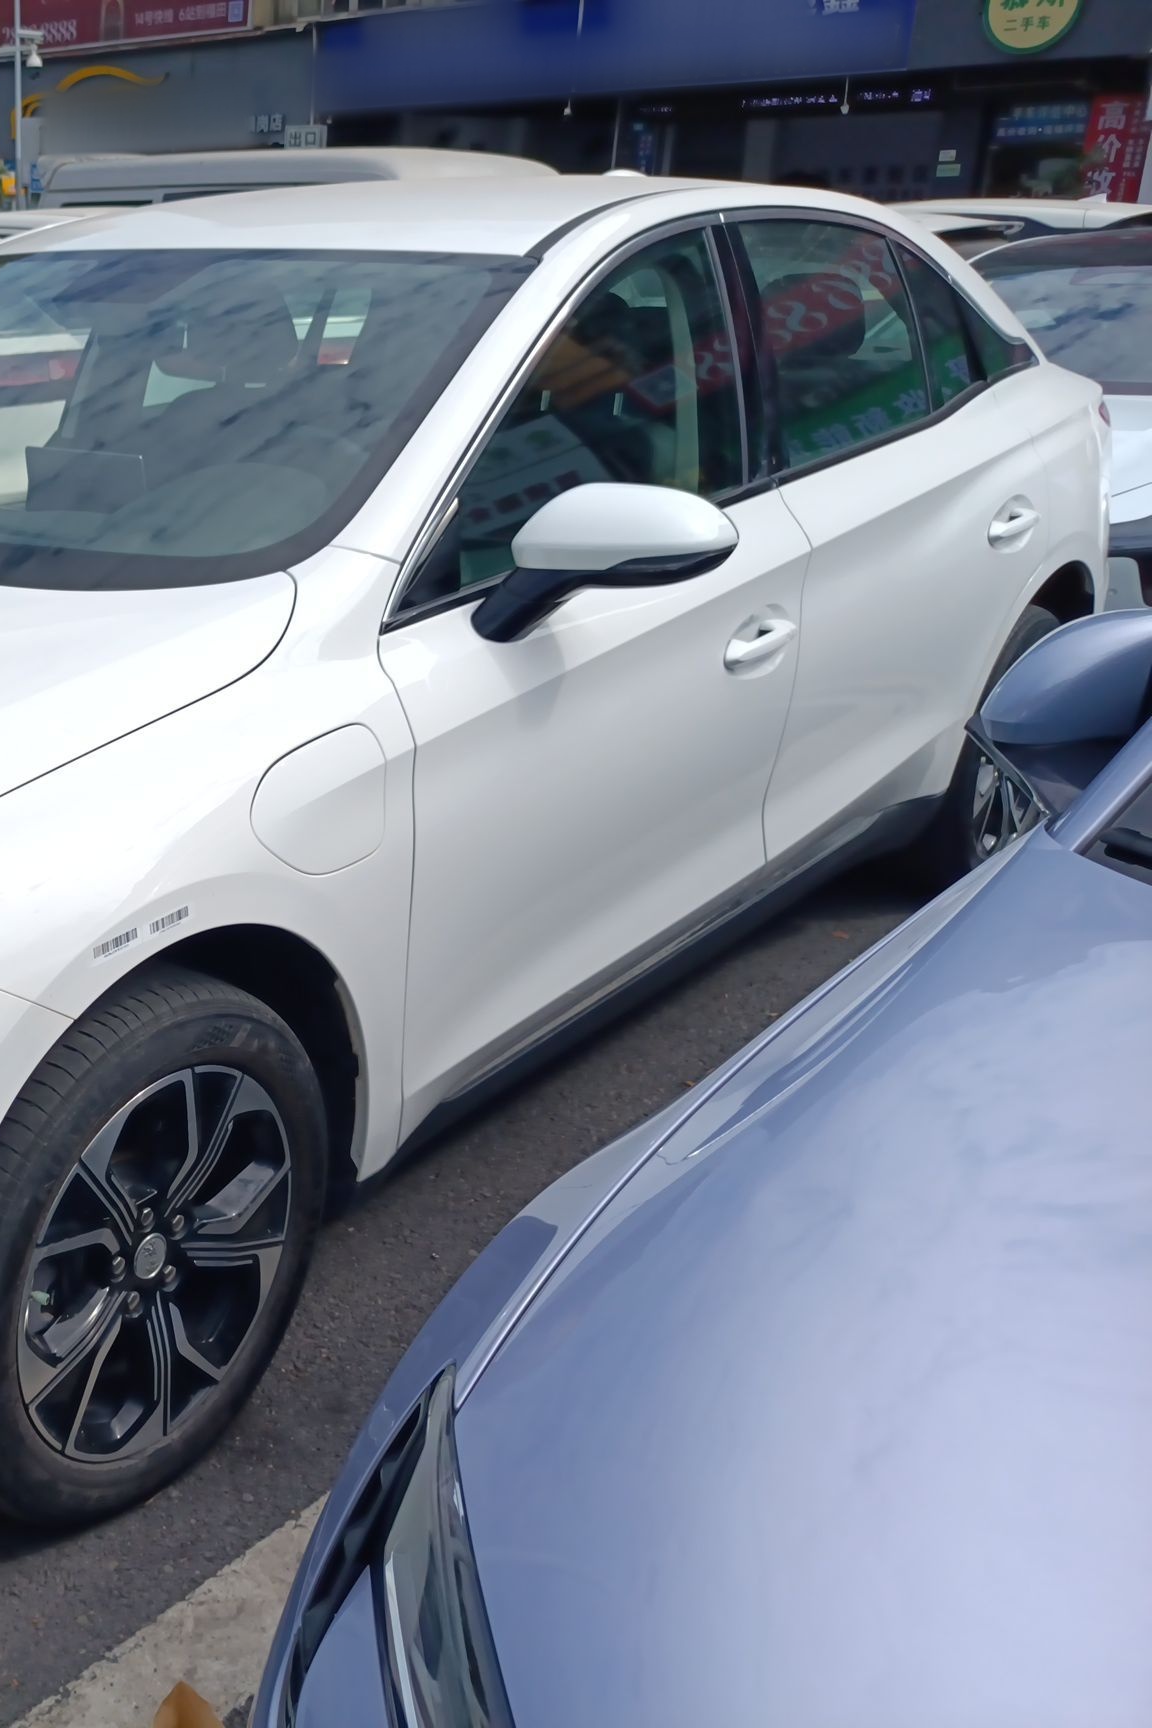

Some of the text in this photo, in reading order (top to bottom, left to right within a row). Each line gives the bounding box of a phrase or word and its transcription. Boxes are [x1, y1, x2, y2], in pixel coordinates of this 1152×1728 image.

[1003, 15, 1051, 32] 二手车
[288, 131, 317, 148] 出口
